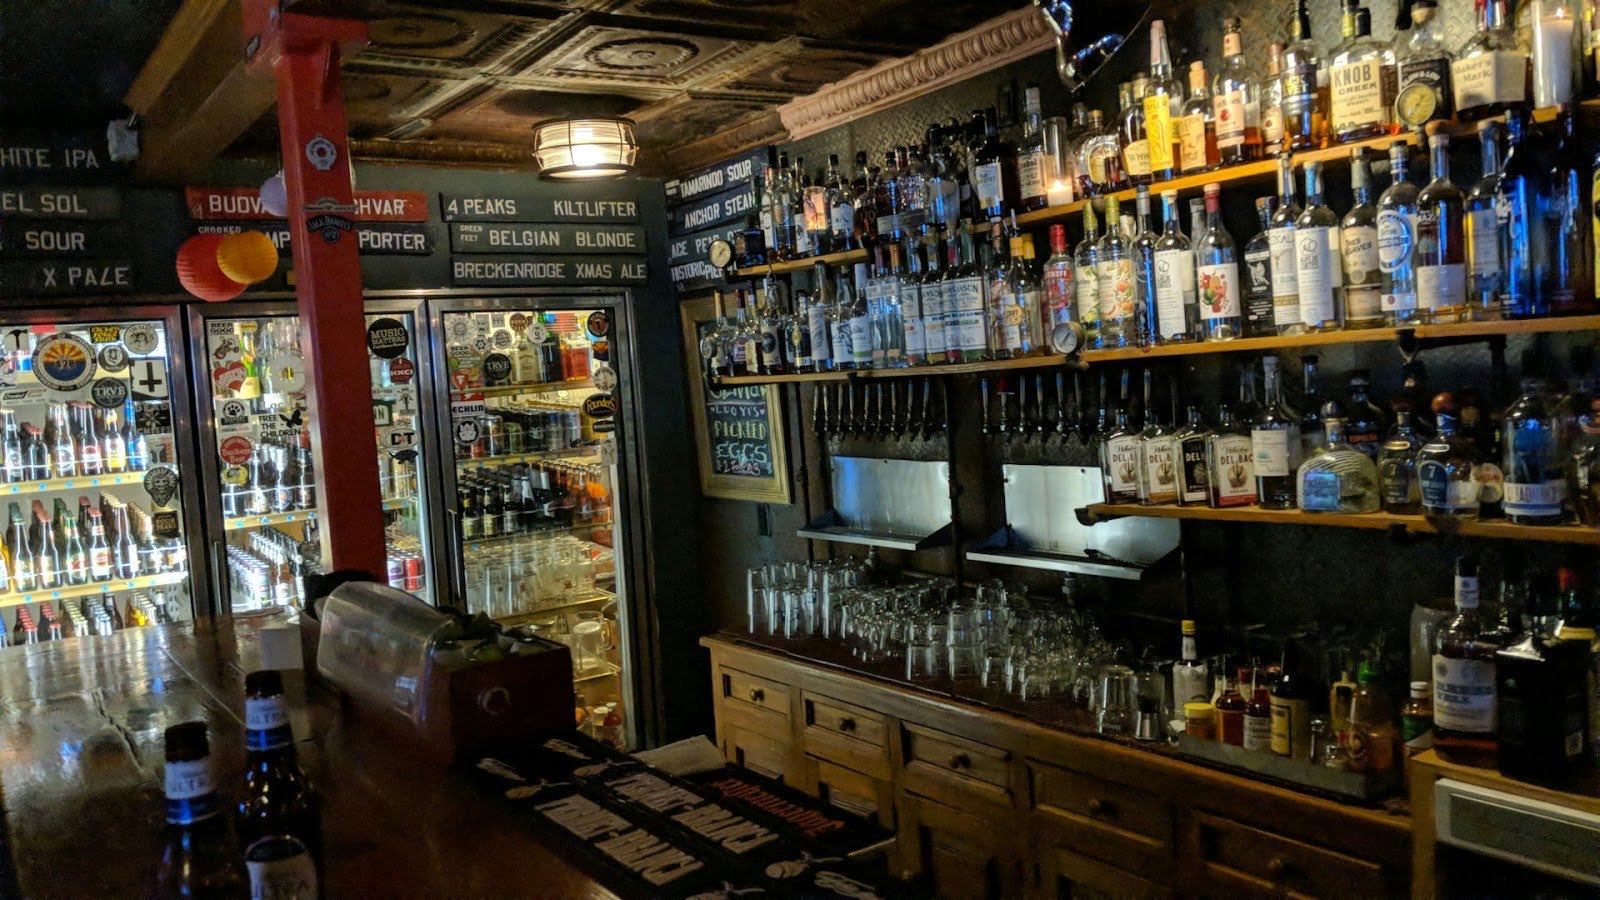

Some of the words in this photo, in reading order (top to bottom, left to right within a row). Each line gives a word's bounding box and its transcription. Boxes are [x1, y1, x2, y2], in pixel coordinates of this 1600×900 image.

[1333, 63, 1372, 86] KNOB
[1338, 81, 1377, 95] CREEK
[65, 149, 99, 168] IPA
[680, 170, 723, 198] TAMARINDO
[727, 159, 752, 181] SOUR
[40, 194, 88, 214] SOL
[208, 194, 268, 214] BUDV
[448, 199, 459, 214] 4
[464, 199, 516, 215] PEAKS
[554, 200, 636, 216] KILTLIFTER
[685, 203, 720, 229] ANCHOR
[198, 225, 242, 235] CROOKED
[460, 234, 478, 242] FEET
[489, 230, 560, 247] BELGIAN
[576, 232, 636, 247] BLONDE
[25, 231, 85, 251] SOUR
[359, 231, 425, 250] PORTER
[671, 241, 688, 258] ACE
[68, 266, 130, 286] PALE
[454, 262, 565, 279] BRECKENRIDGE
[576, 263, 612, 279] XMAS
[621, 264, 646, 279] ALE
[671, 261, 706, 281] HISTORIC
[370, 328, 405, 339] MUSIC
[371, 336, 406, 345] MATTERS
[486, 361, 509, 370] TRVE
[93, 386, 126, 396] TRVE
[260, 429, 300, 438] CHILDREN
[261, 422, 276, 430] THE
[714, 420, 766, 440] PICKLED
[716, 441, 768, 463] EGGS
[1113, 453, 1129, 463] DEL
[1150, 454, 1165, 464] DEL
[1186, 452, 1200, 462] DEL
[1220, 454, 1235, 465] DEL
[1429, 465, 1436, 478] 7
